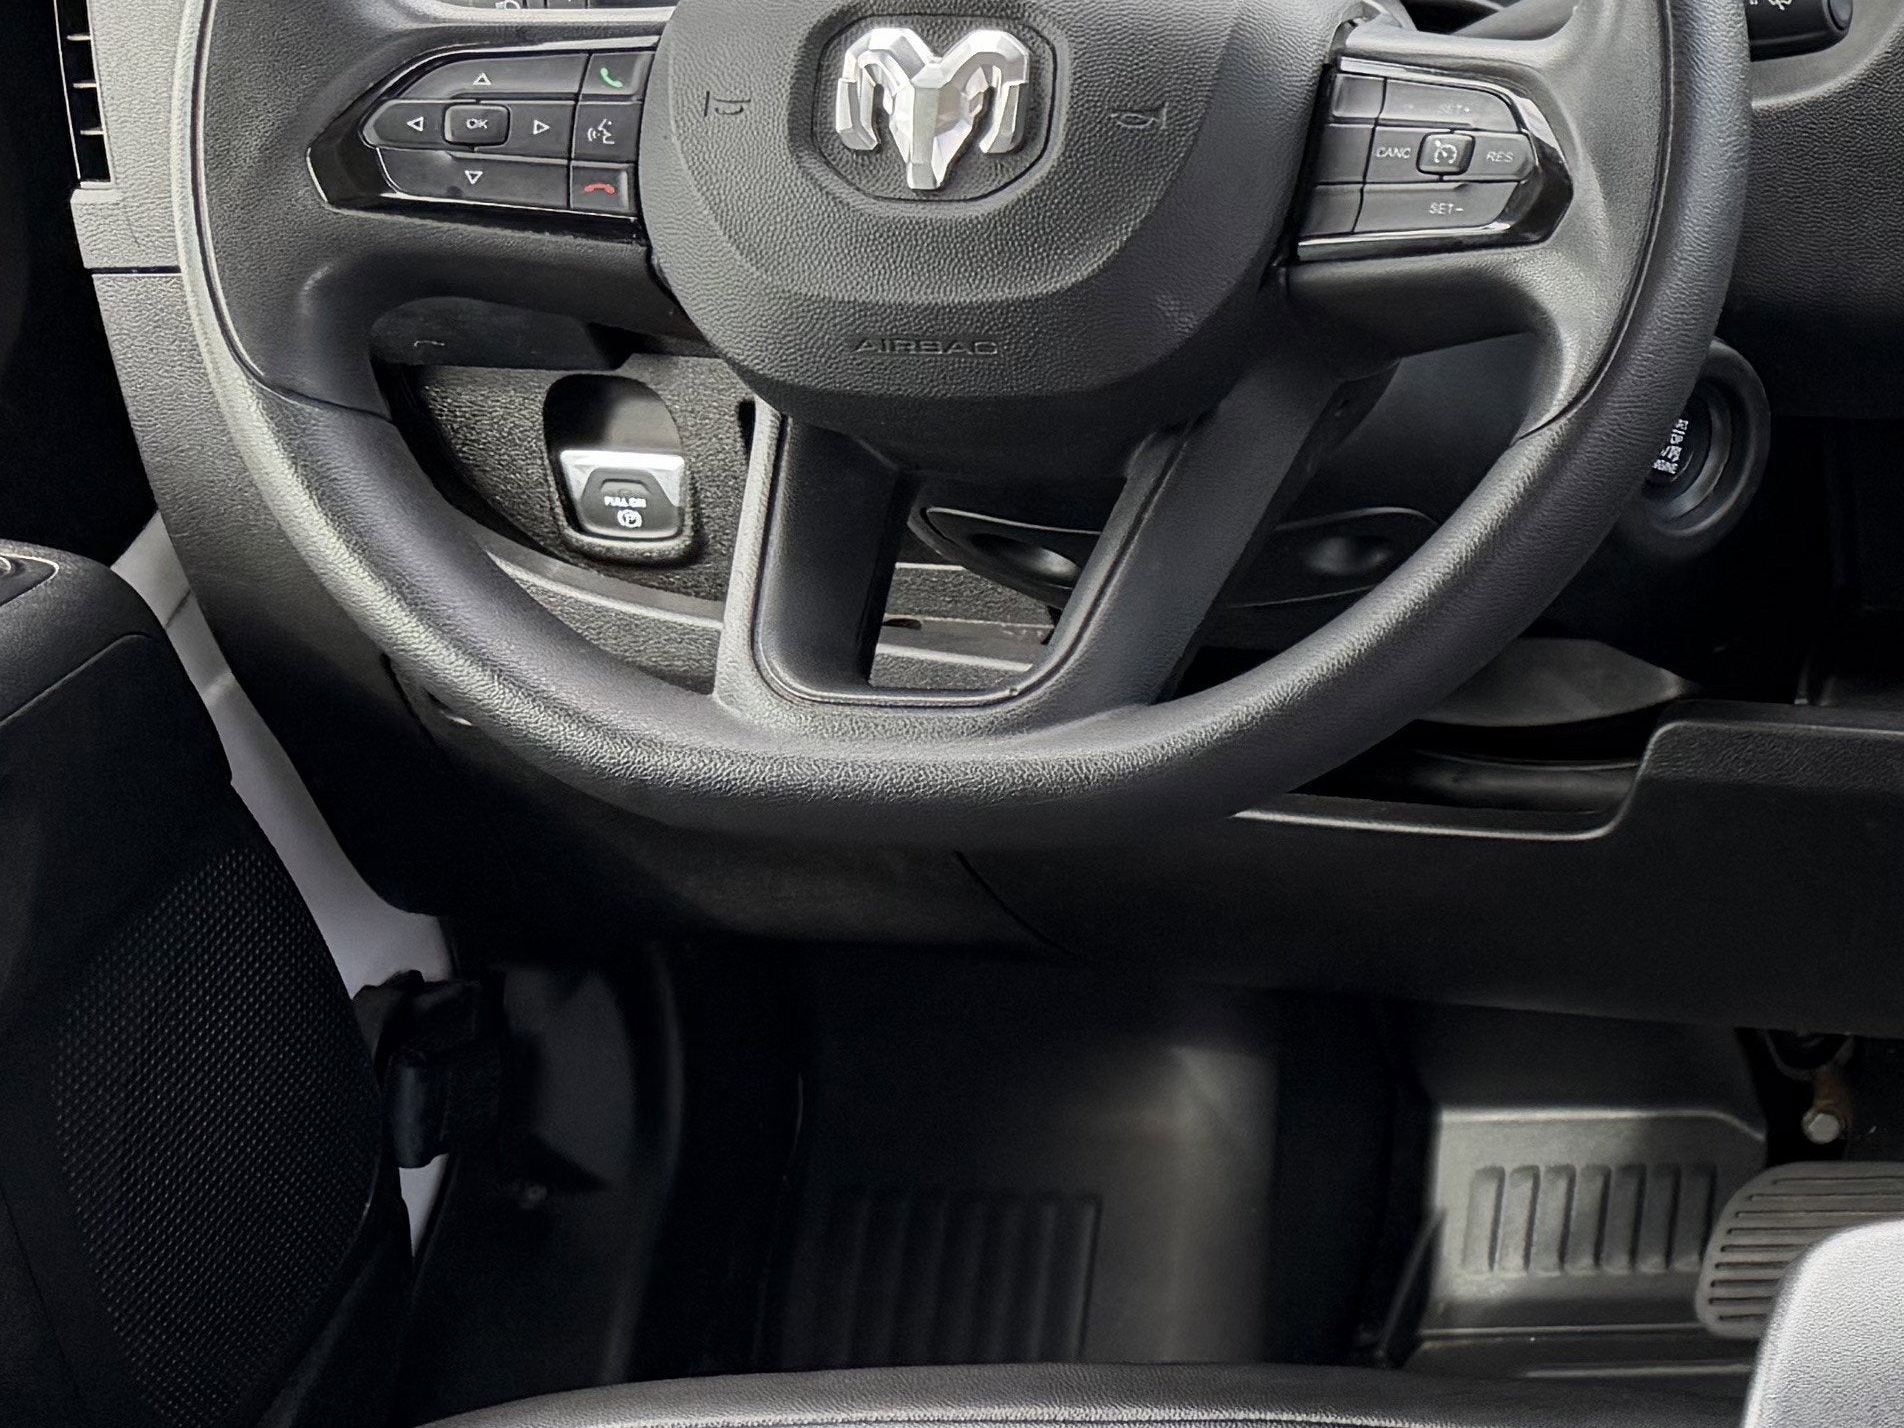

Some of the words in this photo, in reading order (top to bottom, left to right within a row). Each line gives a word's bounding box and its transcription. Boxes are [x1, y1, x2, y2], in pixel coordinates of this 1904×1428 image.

[466, 119, 488, 130] OK
[1376, 146, 1411, 159] CANC
[1486, 151, 1514, 163] RES
